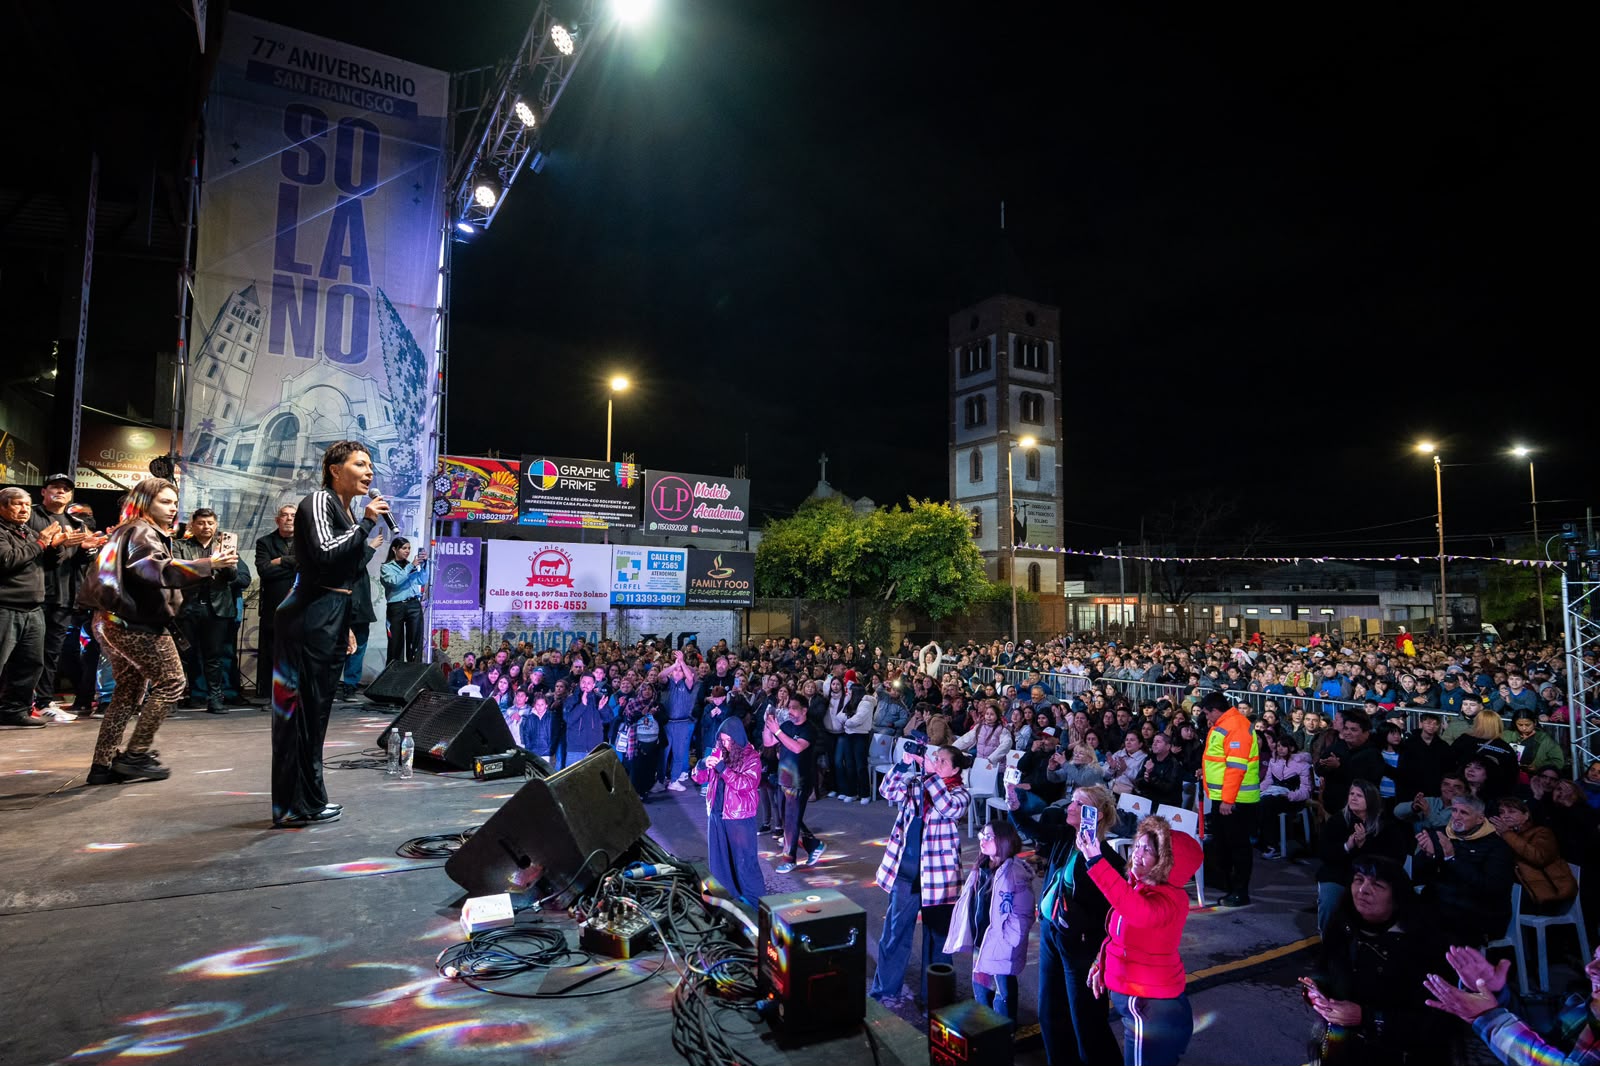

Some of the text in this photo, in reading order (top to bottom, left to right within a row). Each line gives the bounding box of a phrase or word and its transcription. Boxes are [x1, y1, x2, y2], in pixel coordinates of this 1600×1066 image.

[288, 47, 416, 97] ANIVERSARIO
[273, 69, 394, 114] SAN FRANCISCO
[117, 462, 138, 470] PARA
[76, 470, 129, 480] WHASAPP
[560, 465, 611, 479] GRAPHIC
[560, 479, 597, 491] PRIME
[694, 481, 731, 500] Models
[658, 486, 690, 513] LP
[693, 502, 745, 521] Academia
[650, 553, 670, 561] CALLE
[691, 578, 722, 588] FAMILY
[724, 580, 750, 589] FOOD
[489, 589, 510, 597] Calle
[625, 594, 634, 603] 11
[635, 594, 681, 604] 3393-9912
[523, 600, 588, 610] 11 3266-4553
